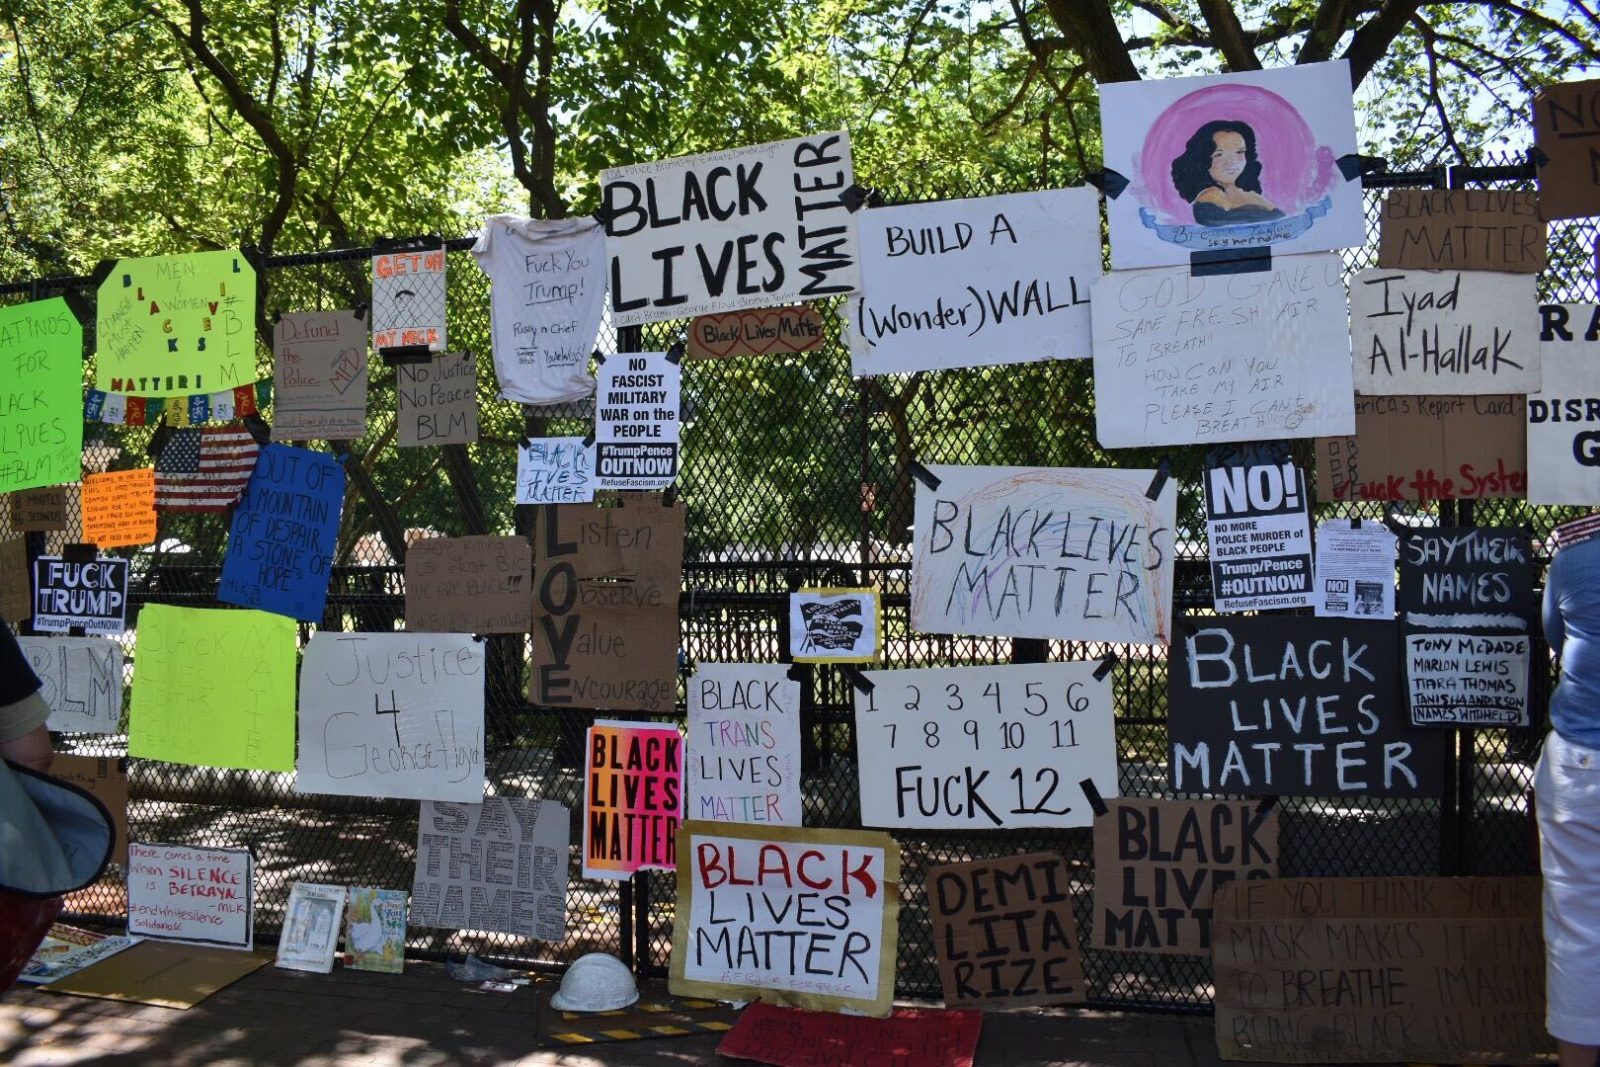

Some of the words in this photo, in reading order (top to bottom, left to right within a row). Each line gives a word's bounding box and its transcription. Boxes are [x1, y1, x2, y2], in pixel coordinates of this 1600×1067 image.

[603, 162, 768, 237] BLACK
[794, 135, 855, 296] MATTER
[1387, 191, 1456, 219] BLACK
[886, 222, 973, 257] BUILD
[990, 214, 1018, 245] A
[1400, 224, 1541, 265] MATTER
[376, 252, 422, 279] GET
[525, 253, 561, 274] Fuck
[563, 249, 590, 274] You
[611, 232, 785, 313] LIVES
[1275, 298, 1318, 322] AIR
[1363, 272, 1461, 337] Iyad
[702, 324, 739, 344] Black
[14, 350, 52, 378] FOR
[400, 363, 429, 386] No
[628, 357, 647, 371] NO
[1145, 366, 1180, 385] HOW
[1245, 357, 1280, 372] YOU
[607, 390, 667, 404] MILITARY
[611, 374, 664, 388] FASCIST
[1155, 383, 1200, 398] TAKE
[1250, 374, 1284, 392] AIR
[400, 387, 428, 410] No
[600, 408, 629, 421] WAR
[633, 410, 650, 421] on
[654, 407, 675, 420] the
[417, 411, 467, 441] BLM
[613, 424, 661, 438] PEOPLE
[0, 454, 52, 484] #BLM
[600, 457, 673, 475] OUTNOW
[601, 446, 673, 459] #TrumpPence
[305, 461, 337, 494] OF
[1209, 462, 1300, 515] NO!
[235, 511, 261, 538] OF
[930, 499, 1054, 561] BLACK
[1060, 511, 1168, 571] LIVES
[1214, 524, 1228, 533] NO
[1229, 521, 1258, 532] MORE
[1215, 535, 1248, 545] POLICE
[1250, 530, 1292, 543] MURDER
[1294, 529, 1304, 539] of
[232, 535, 244, 557] A
[249, 540, 304, 570] STONE
[309, 553, 334, 577] OF
[1216, 545, 1248, 557] BLACK
[1249, 542, 1286, 554] PEOPLE
[1407, 534, 1458, 567] SAY
[48, 562, 117, 590] FUCK
[1219, 558, 1304, 576] Trump/Pence
[946, 561, 1140, 624] MATTER
[1221, 573, 1306, 596] #OUTNOW
[1422, 572, 1511, 607] NAMES
[40, 588, 123, 616] TRUMP
[1223, 594, 1307, 610] RefuseFascism.org
[326, 637, 480, 687] Justice
[1185, 628, 1376, 688] BLACK
[1412, 638, 1452, 653] TONY
[1465, 659, 1510, 676] LEWIS
[701, 680, 784, 714] BLACK
[865, 687, 879, 713] 1
[904, 685, 921, 711] 2
[945, 683, 964, 711] 3
[982, 681, 1002, 714] 4
[1023, 682, 1048, 717] 5
[1066, 682, 1090, 712] 6
[1459, 677, 1516, 693] THOMAS
[375, 689, 401, 748] 4
[1229, 694, 1380, 736] LIVES
[703, 719, 777, 750] TRANS
[882, 723, 898, 749] 7
[922, 721, 941, 748] 8
[963, 719, 980, 750] 9
[1000, 721, 1025, 750] 10
[1050, 718, 1081, 749] 11
[592, 734, 679, 773] BLACK
[1173, 740, 1419, 791] MATTER
[700, 755, 783, 788] LIVES
[591, 773, 679, 812] LIVES
[700, 793, 783, 822] MATTER
[895, 764, 1004, 827] FUCK
[1010, 766, 1072, 816] 12
[432, 796, 544, 843] SAY
[1116, 803, 1272, 866] BLACK
[589, 811, 677, 865] MATTER
[169, 865, 242, 885] SILENCE
[422, 834, 562, 895] THEIR
[697, 843, 877, 899] BLACK
[936, 858, 1068, 917] DEMI
[1283, 881, 1336, 917] YOU
[1353, 880, 1439, 915] THINK
[1456, 881, 1533, 913] YOUR
[410, 881, 566, 942] NAMES
[709, 890, 851, 930] LIVES
[944, 909, 1072, 961] LITA
[1230, 924, 1313, 965] MASK
[1326, 922, 1425, 962] MAKES
[696, 925, 871, 985] MATTER
[953, 957, 1074, 1000] RIZE
